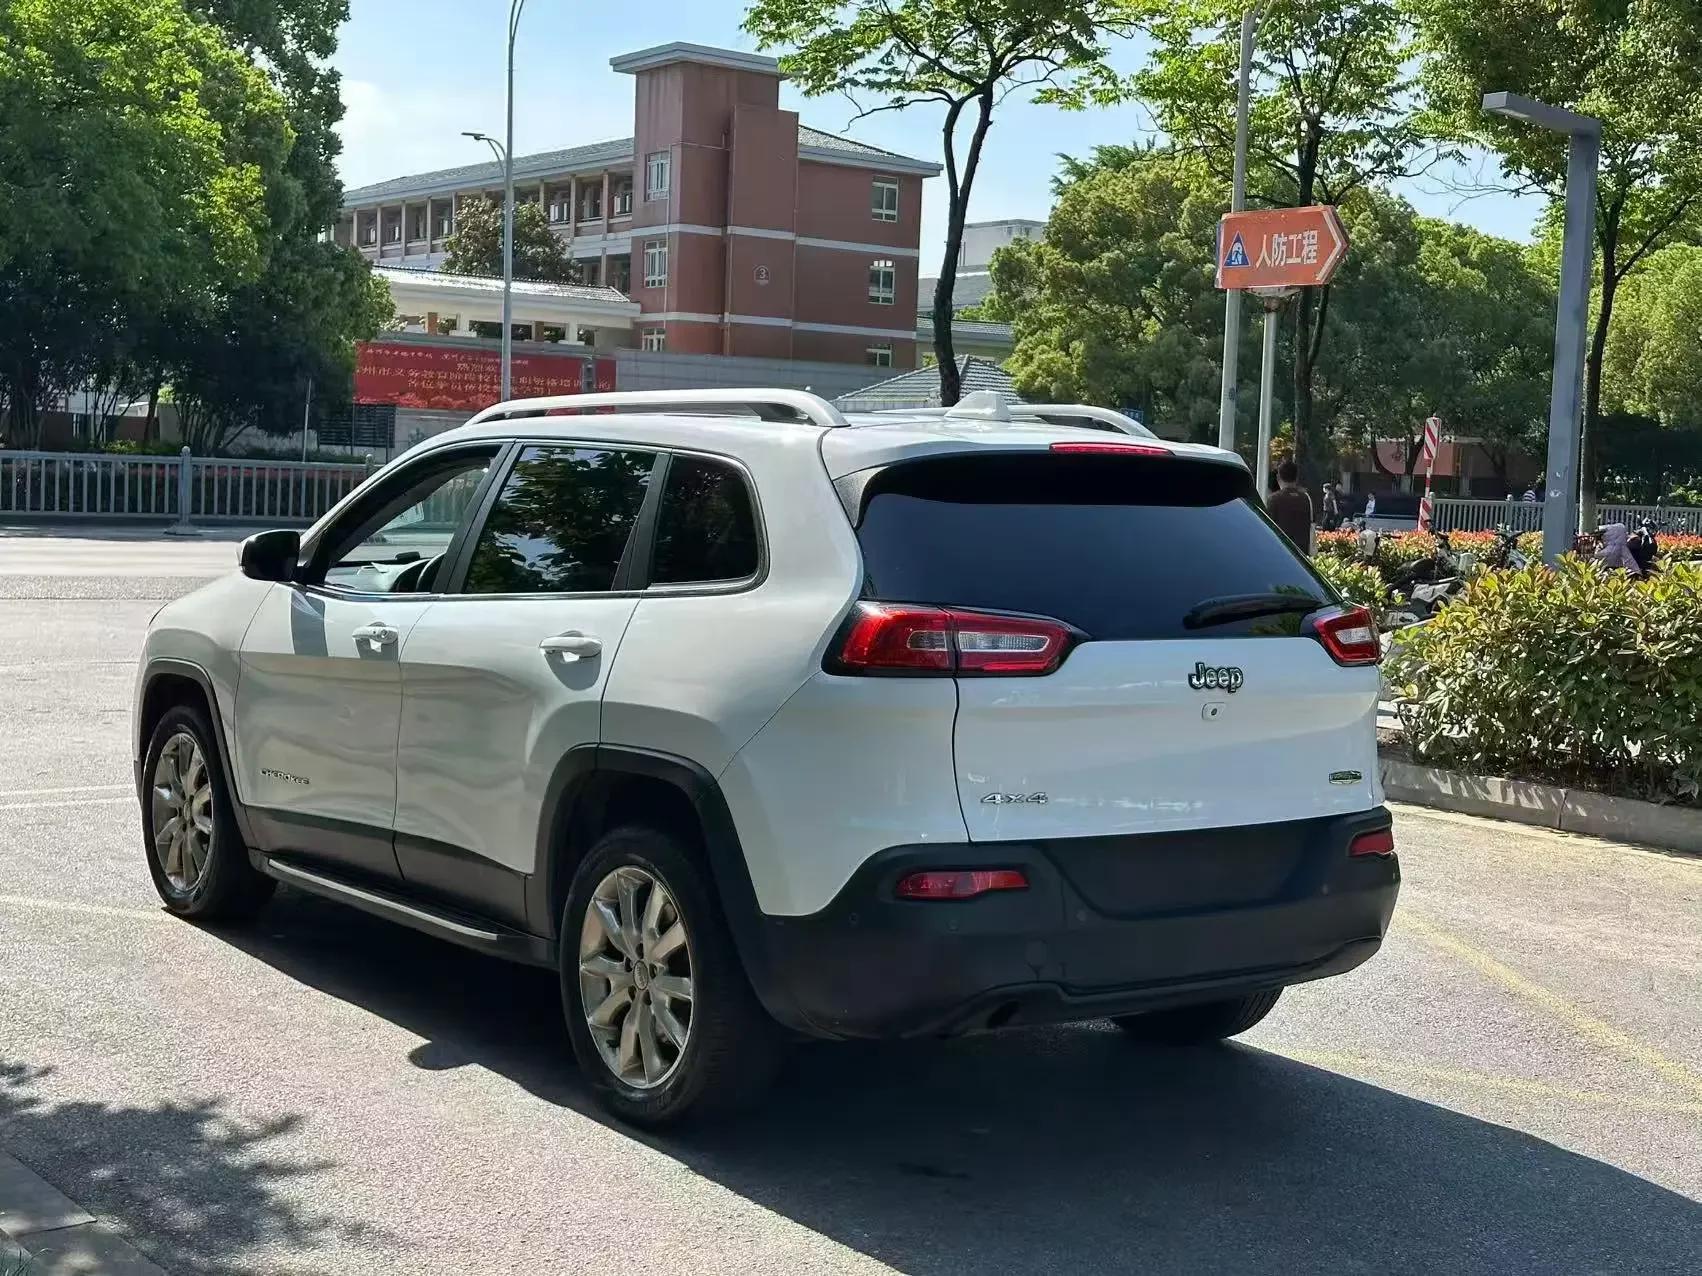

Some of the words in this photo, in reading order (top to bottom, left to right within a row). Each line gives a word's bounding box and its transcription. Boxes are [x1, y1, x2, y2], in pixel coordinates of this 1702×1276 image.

[1256, 230, 1318, 268] 人防工程
[1188, 662, 1243, 693] Jeep
